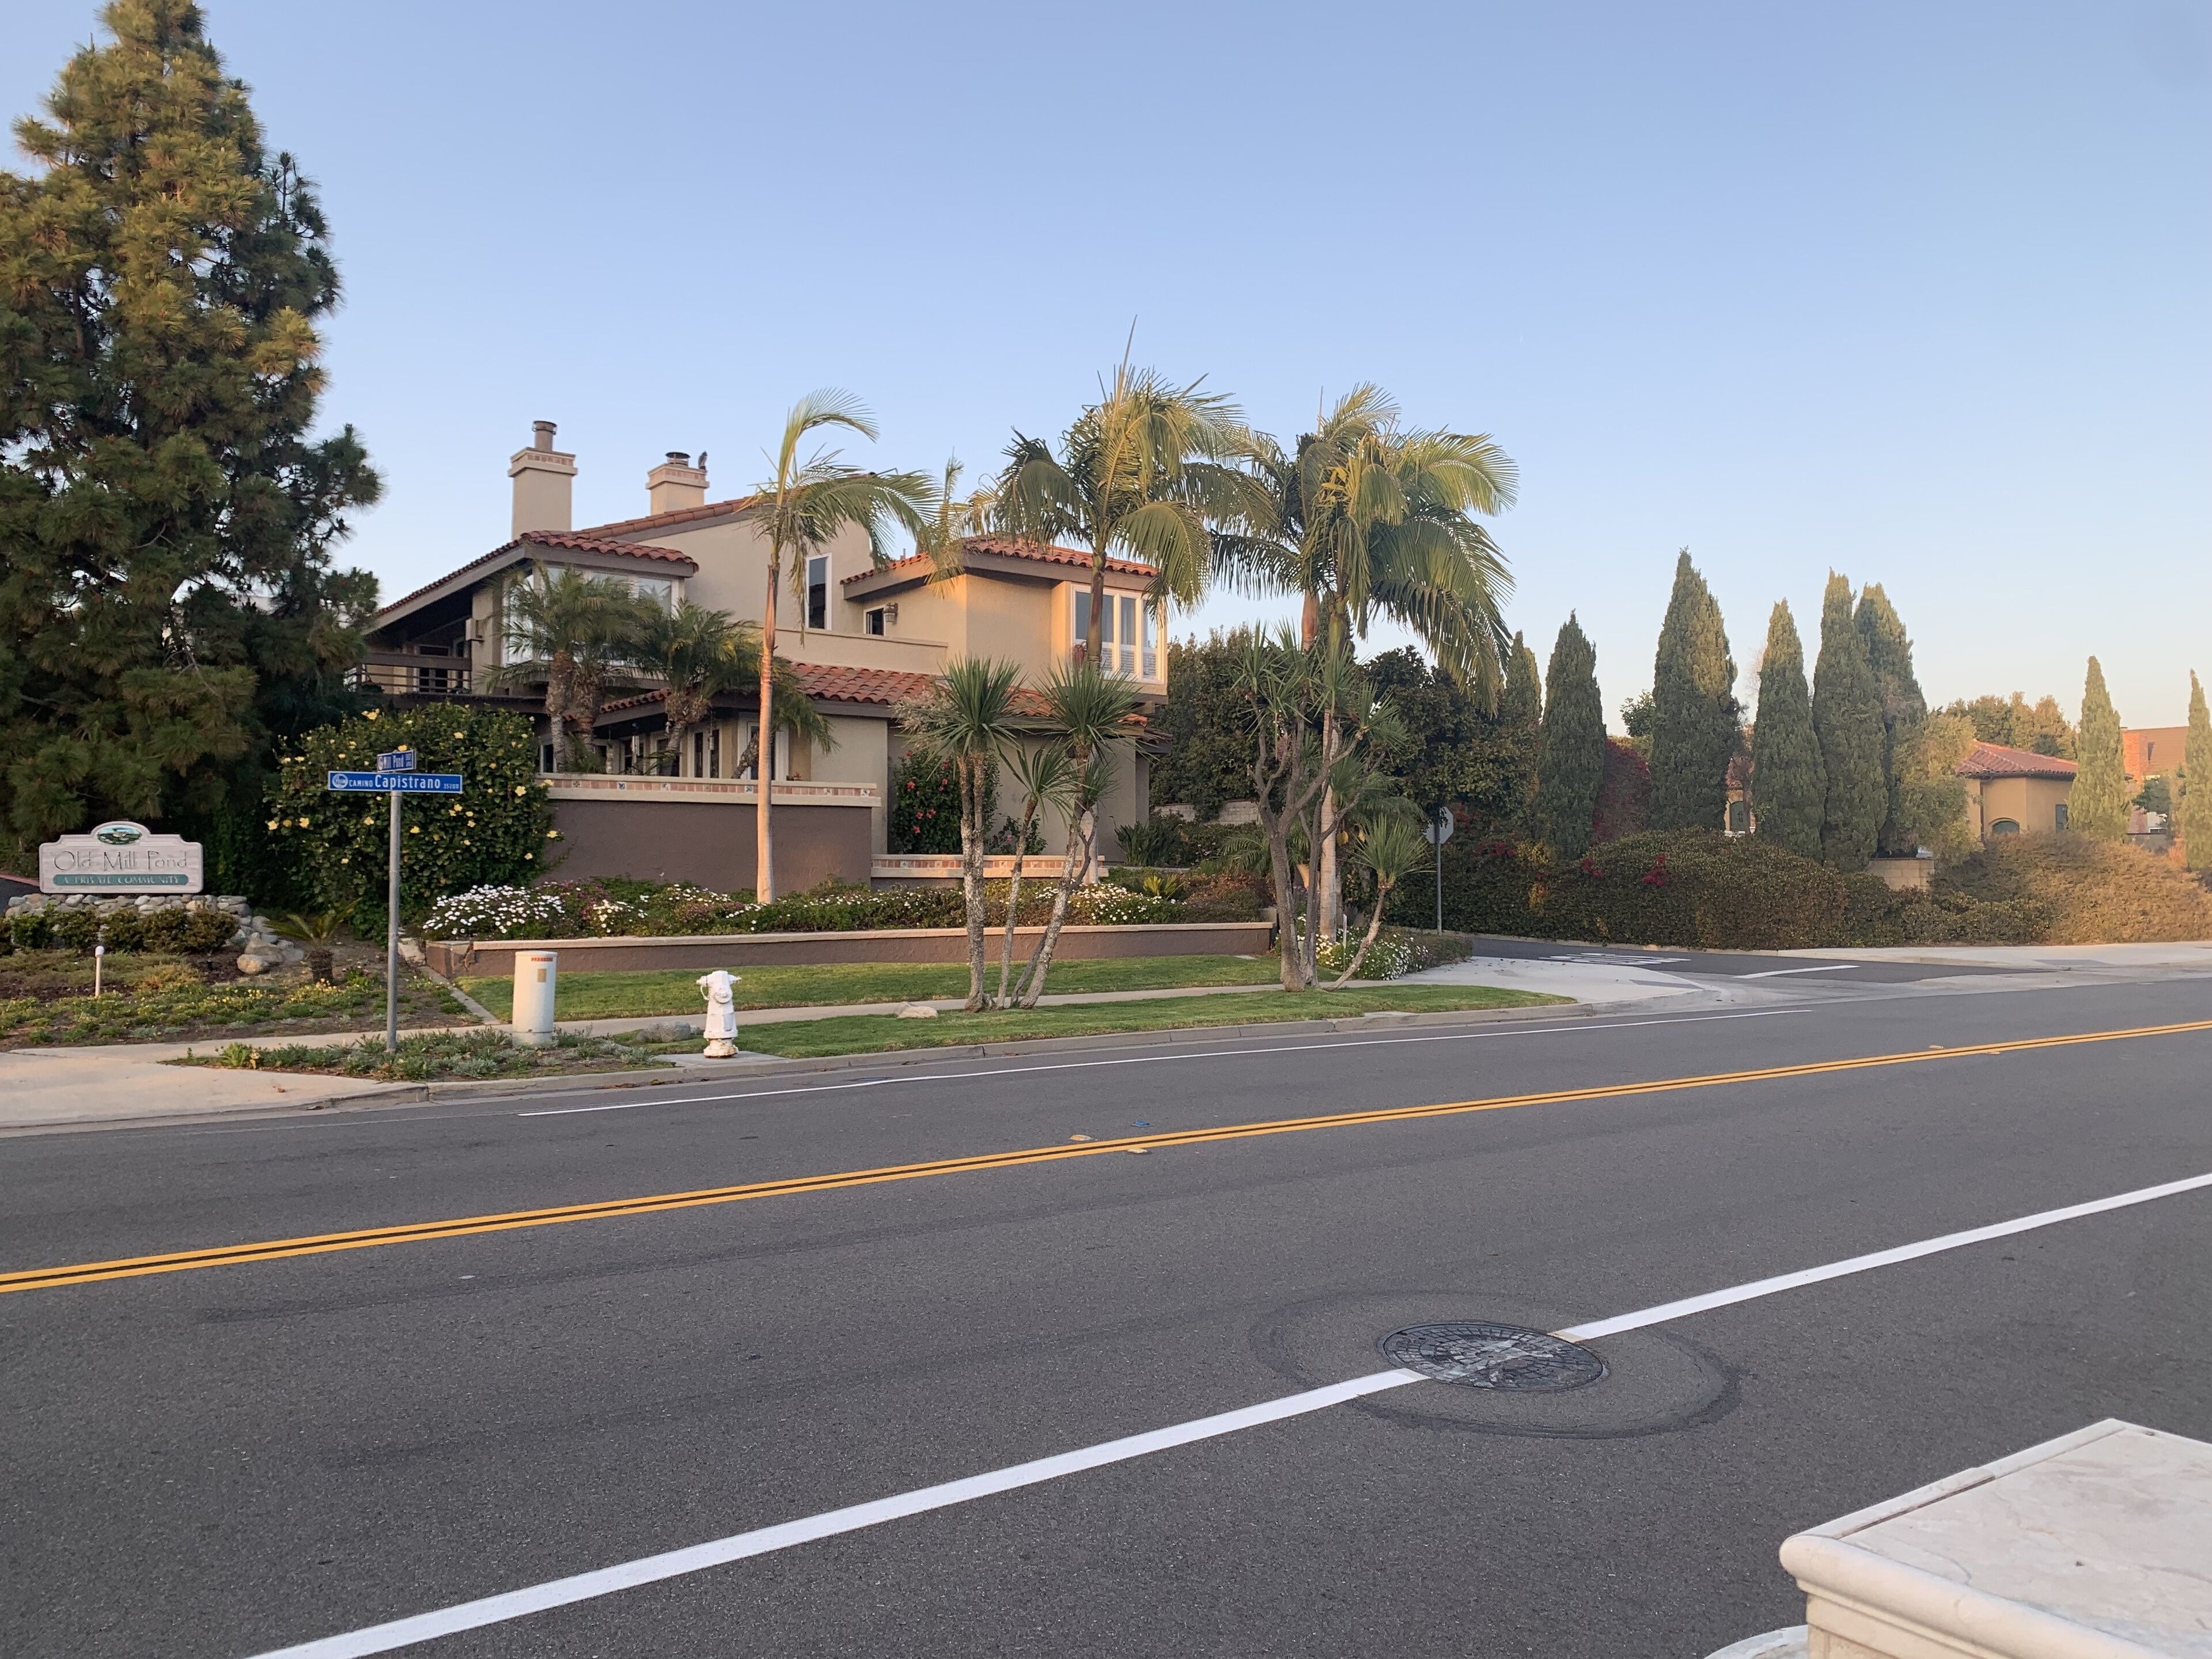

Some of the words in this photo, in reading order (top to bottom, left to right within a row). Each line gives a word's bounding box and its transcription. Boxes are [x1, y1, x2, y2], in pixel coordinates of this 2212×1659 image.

[349, 779, 373, 787] CAMINO
[375, 774, 441, 790] Capistrano
[54, 850, 91, 870] Old
[103, 851, 135, 870] Mill
[147, 850, 187, 870] Pond
